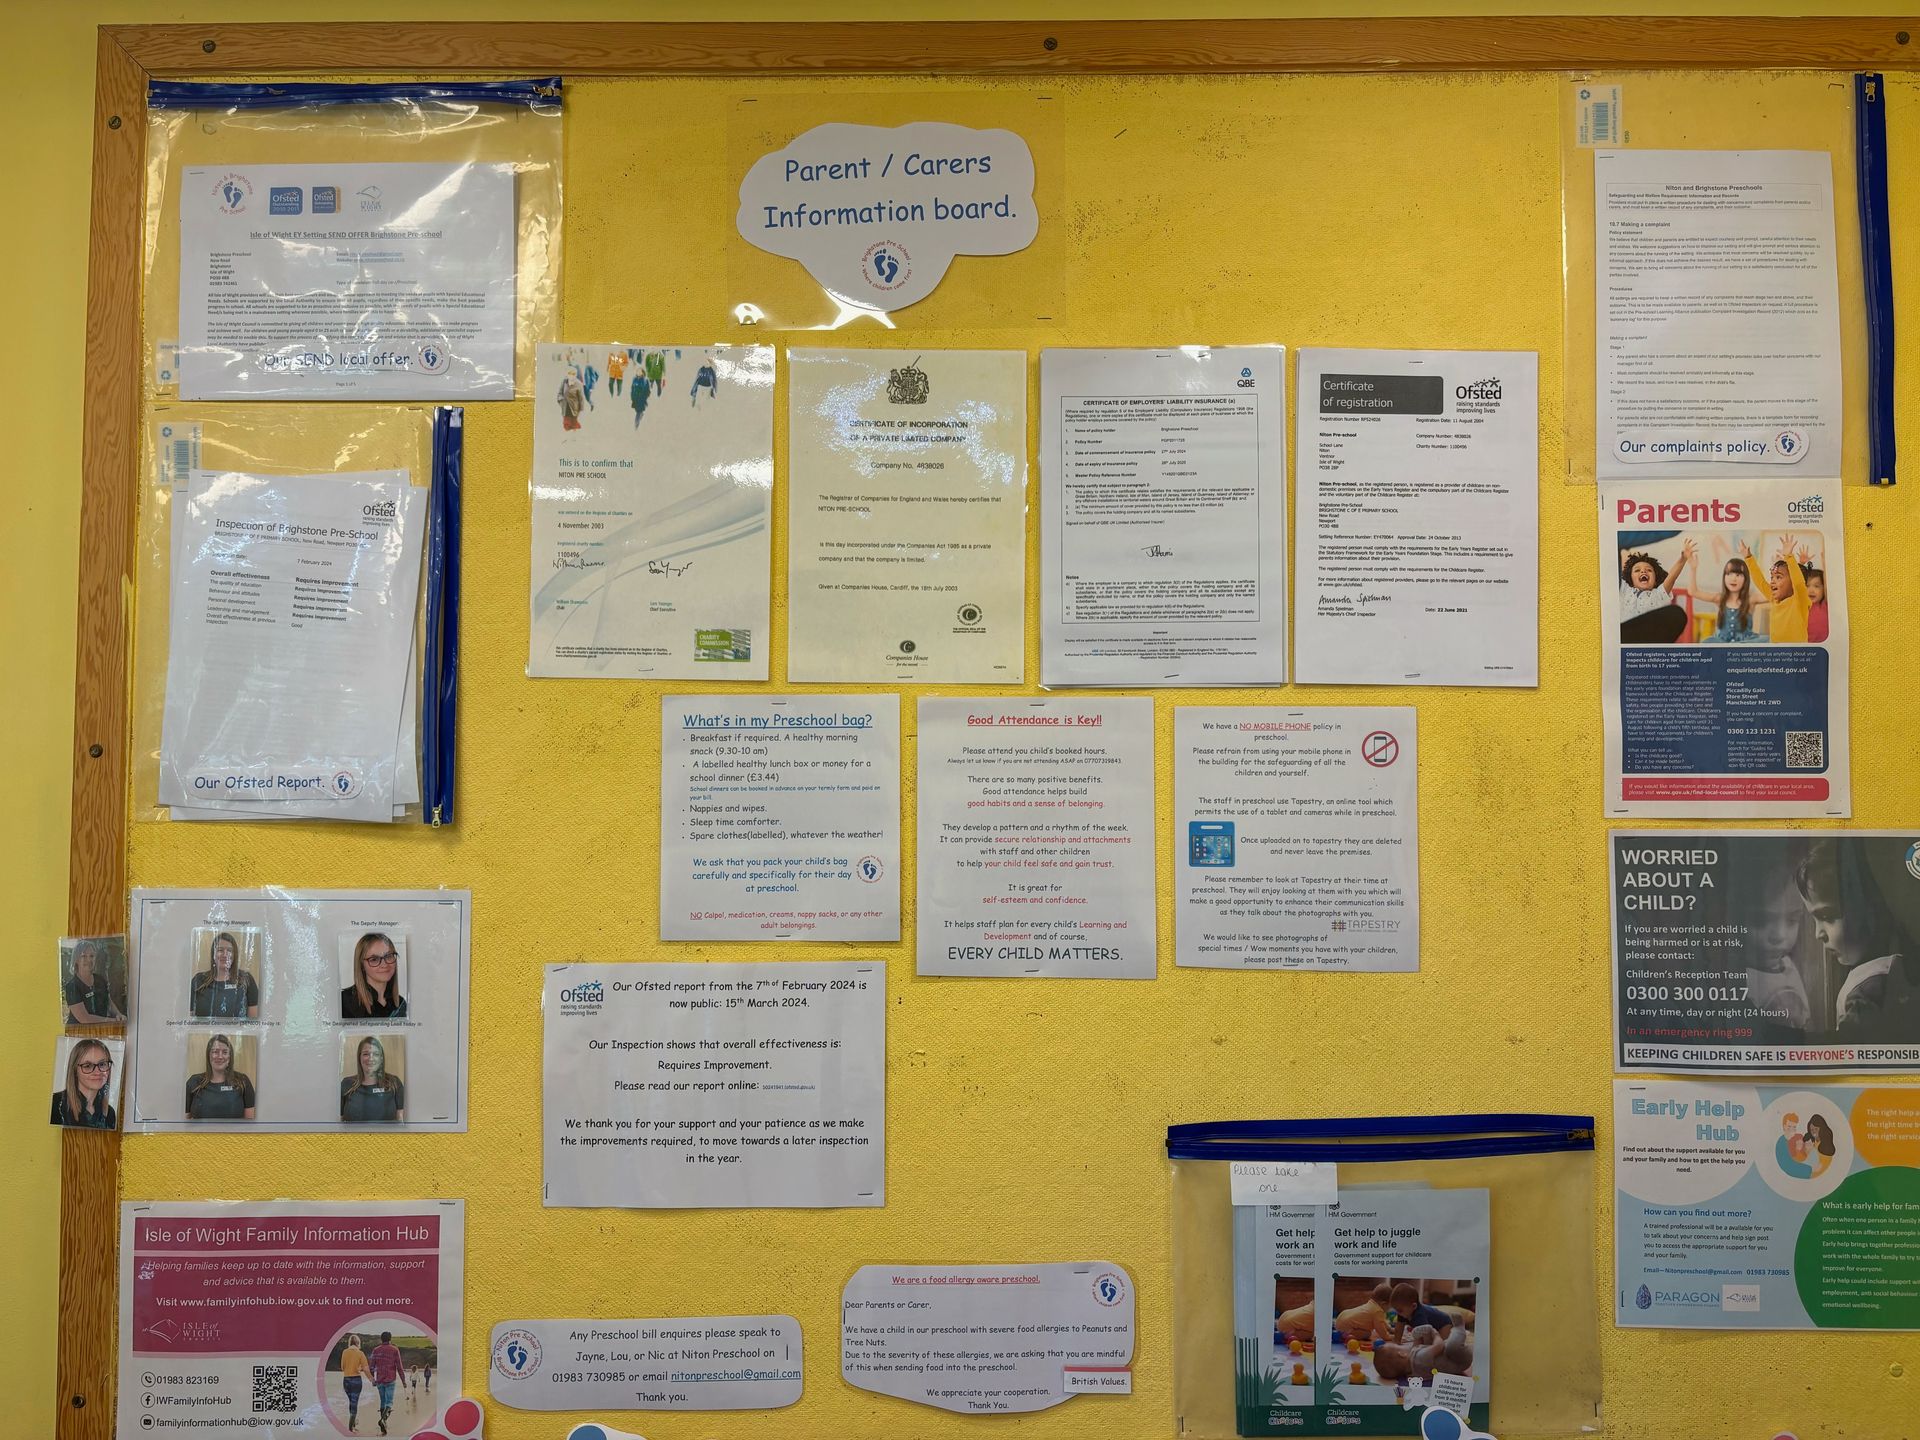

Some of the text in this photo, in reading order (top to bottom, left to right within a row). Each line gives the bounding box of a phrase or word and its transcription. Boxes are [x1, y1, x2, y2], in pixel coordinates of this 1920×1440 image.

[786, 153, 991, 182] Parent / Carers
[764, 194, 1016, 228] Information board.
[250, 230, 261, 238] Isle
[263, 230, 270, 238] of
[272, 230, 292, 240] Wight
[303, 230, 327, 240] Setting
[370, 230, 406, 240] Brighstone
[408, 230, 442, 238] Pre-school
[295, 353, 334, 366] SEND
[340, 352, 368, 366] local
[373, 352, 413, 366] offer.
[1237, 380, 1255, 388] QBE
[1323, 380, 1374, 391] Certificate
[1456, 385, 1501, 399] Ofsted
[1323, 396, 1393, 409] of registration
[850, 420, 895, 428] CERTIFICATE
[897, 420, 907, 428] OF
[1620, 440, 1646, 453] Our
[1651, 439, 1722, 456] complaints
[1727, 440, 1770, 456] policy.
[559, 458, 572, 467] This
[574, 459, 580, 467] is
[591, 459, 617, 467] confirm
[619, 459, 633, 468] that
[871, 462, 901, 470] Company
[363, 504, 396, 517] Ofsted
[1617, 499, 1741, 523] Parents
[1788, 500, 1824, 512] Ofsted
[216, 518, 378, 541] Inspection of Brighstone Pre-School
[232, 572, 270, 580] effectiveness
[295, 577, 320, 585] Requires
[683, 713, 872, 729] What's in my Preschool bag?
[967, 714, 1102, 725] Good Attendance is Key!!
[1278, 769, 1309, 778] yourself.
[194, 777, 220, 789] Our
[225, 775, 273, 791] Ofsted
[277, 776, 325, 791] Report.
[1622, 850, 1718, 865] WORRIED
[1623, 872, 1714, 888] ABOUT A
[1624, 895, 1696, 910] CHILD?
[1348, 920, 1400, 928] TAPESTRY
[948, 946, 1123, 960] EVERY CHILD MATTERS.
[561, 990, 604, 1002] Ofsted
[1627, 986, 1749, 1001] 0300 300 0117
[691, 998, 722, 1011] public:
[726, 997, 744, 1008] 15th
[747, 998, 778, 1008] March
[782, 997, 810, 1007] 2024.
[1628, 1048, 1678, 1059] KEEPING
[1682, 1050, 1742, 1061] CHILDREN
[1745, 1051, 1773, 1061] SAFE
[1776, 1051, 1786, 1061] IS
[1789, 1049, 1854, 1061] EVERYONE'S
[658, 1060, 772, 1072] Requires Improvement.
[1631, 1099, 1744, 1120] Early Help
[1696, 1124, 1739, 1141] Hub
[1234, 1164, 1300, 1177] Please take
[1258, 1184, 1279, 1192] one
[146, 1226, 429, 1246] Isle of Wight Family Information Hub
[1334, 1227, 1421, 1238] Get help to juggle
[1334, 1240, 1397, 1249] work and life
[1655, 1292, 1720, 1302] PARAGON
[156, 1376, 219, 1385] 01983 823169
[552, 1373, 583, 1383] 01983
[586, 1372, 626, 1382] 730985
[642, 1371, 668, 1381] email
[671, 1369, 801, 1382] nitonpreschool@gmail.com
[1071, 1377, 1127, 1386] British Values.
[156, 1396, 232, 1407] IWFamilyInfoHub
[968, 1401, 1009, 1409] Thank You.
[1327, 1408, 1359, 1416] Childcare
[156, 1417, 304, 1429] familyinformationhub@iow.gov.uk
